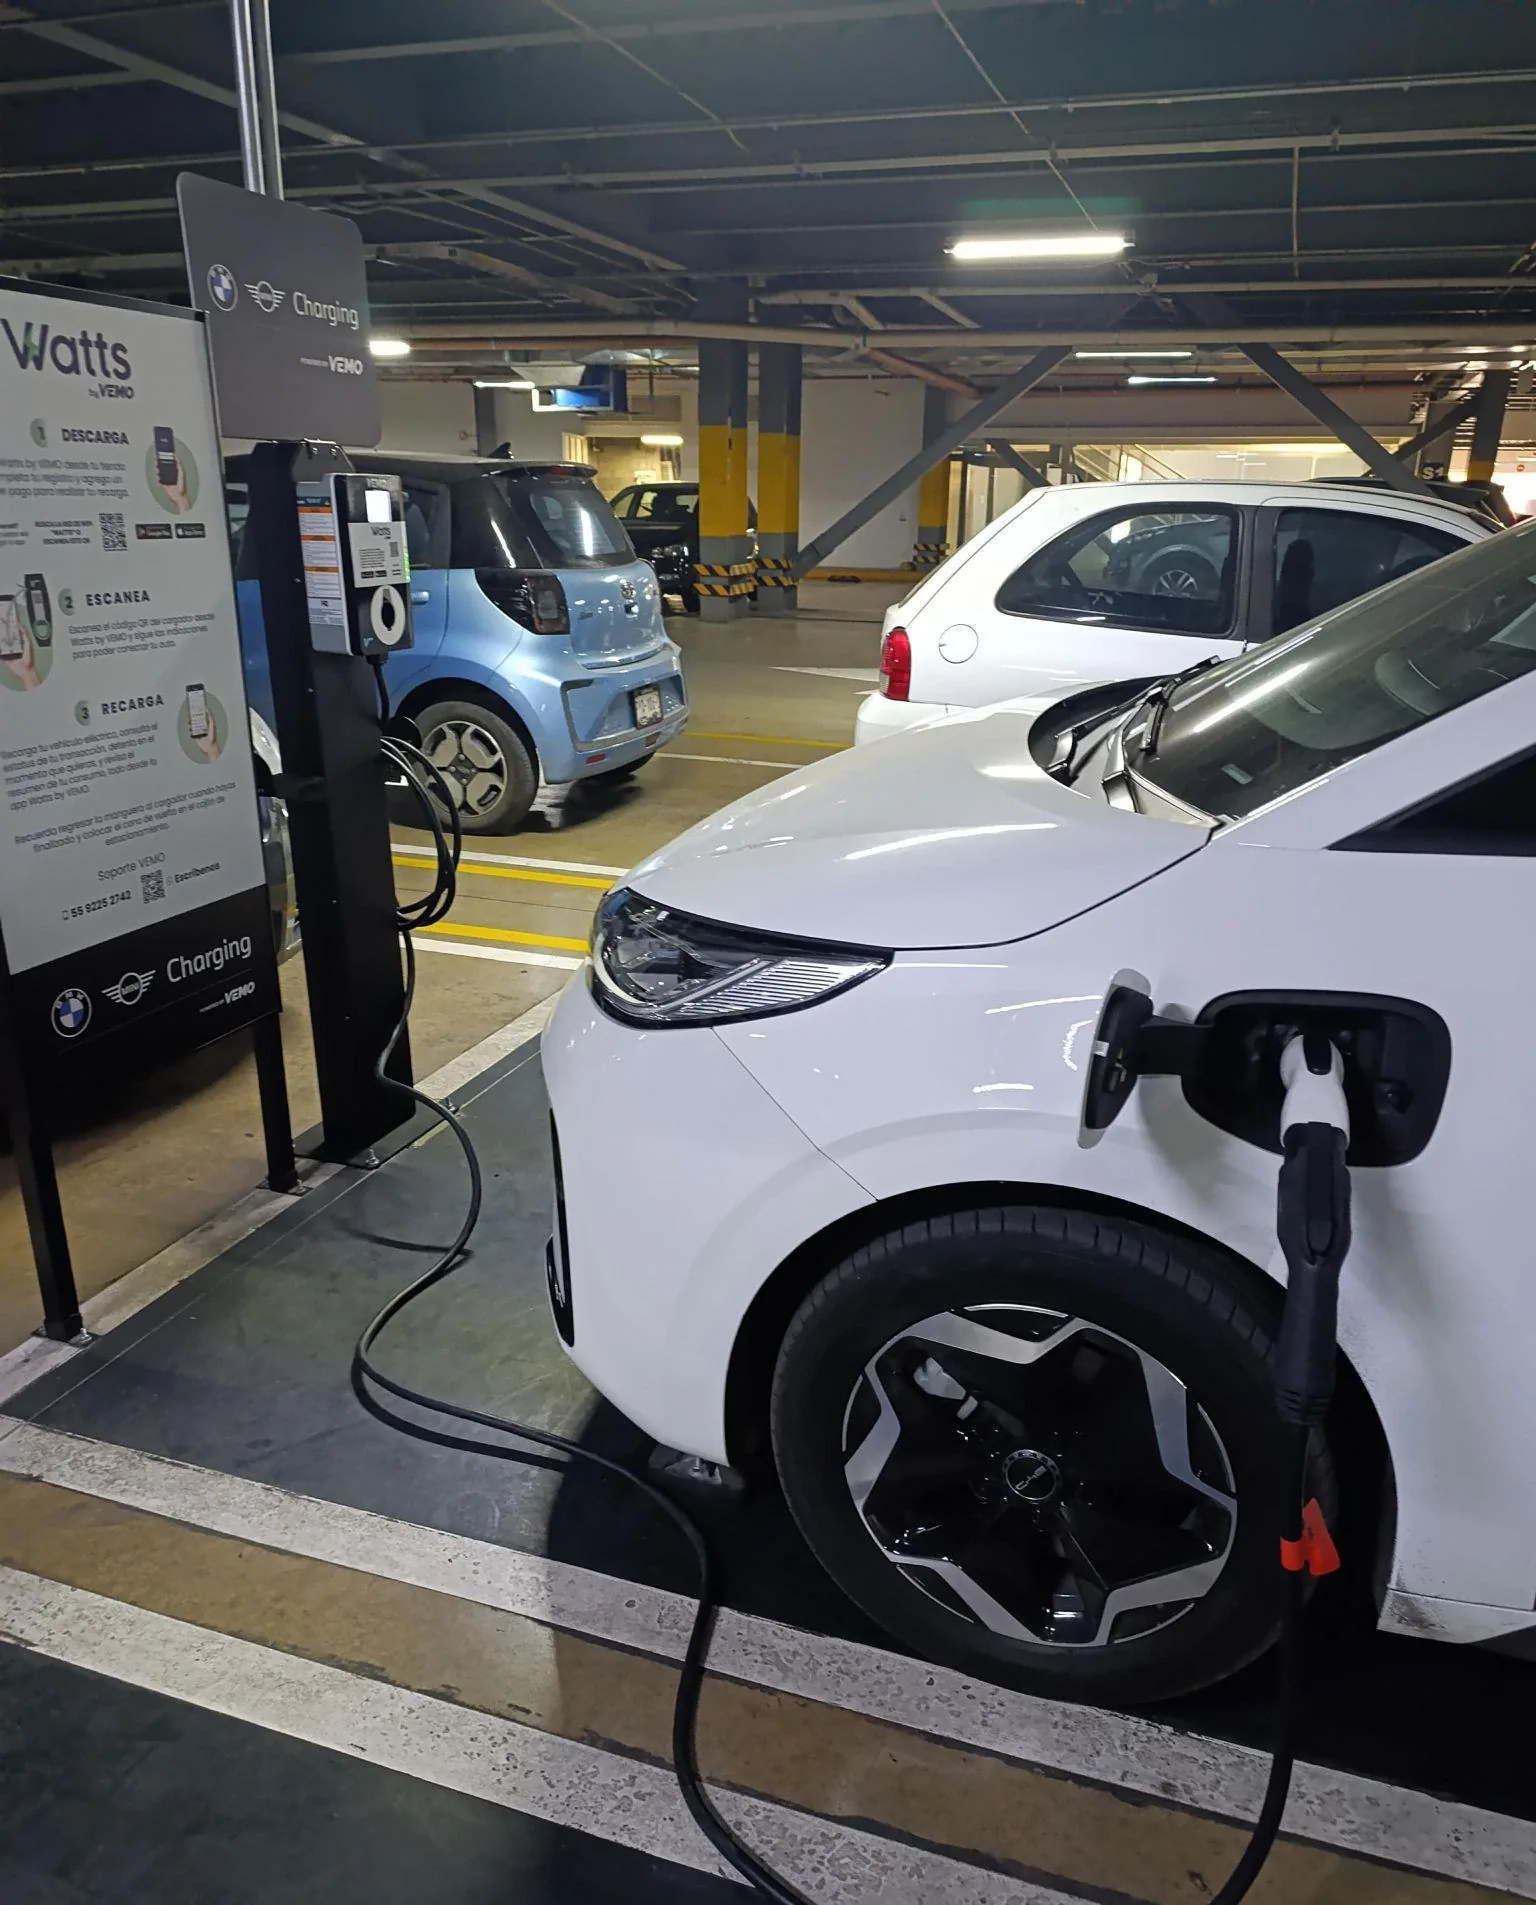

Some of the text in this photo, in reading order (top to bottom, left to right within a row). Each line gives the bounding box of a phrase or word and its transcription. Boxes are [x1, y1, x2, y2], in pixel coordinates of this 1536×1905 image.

[293, 291, 360, 331] Charging
[0, 317, 132, 381] Watts
[328, 355, 364, 376] VEMO
[98, 383, 135, 400] VEMO
[61, 428, 130, 446] DESCARGA
[65, 590, 151, 609] 2 ESCANEA
[82, 694, 165, 720] 3 RECARGA
[97, 852, 166, 882] Soporte VEMO
[70, 889, 132, 919] 55 9225 2742
[166, 935, 252, 983] Charging
[224, 981, 256, 1005] VEMO
